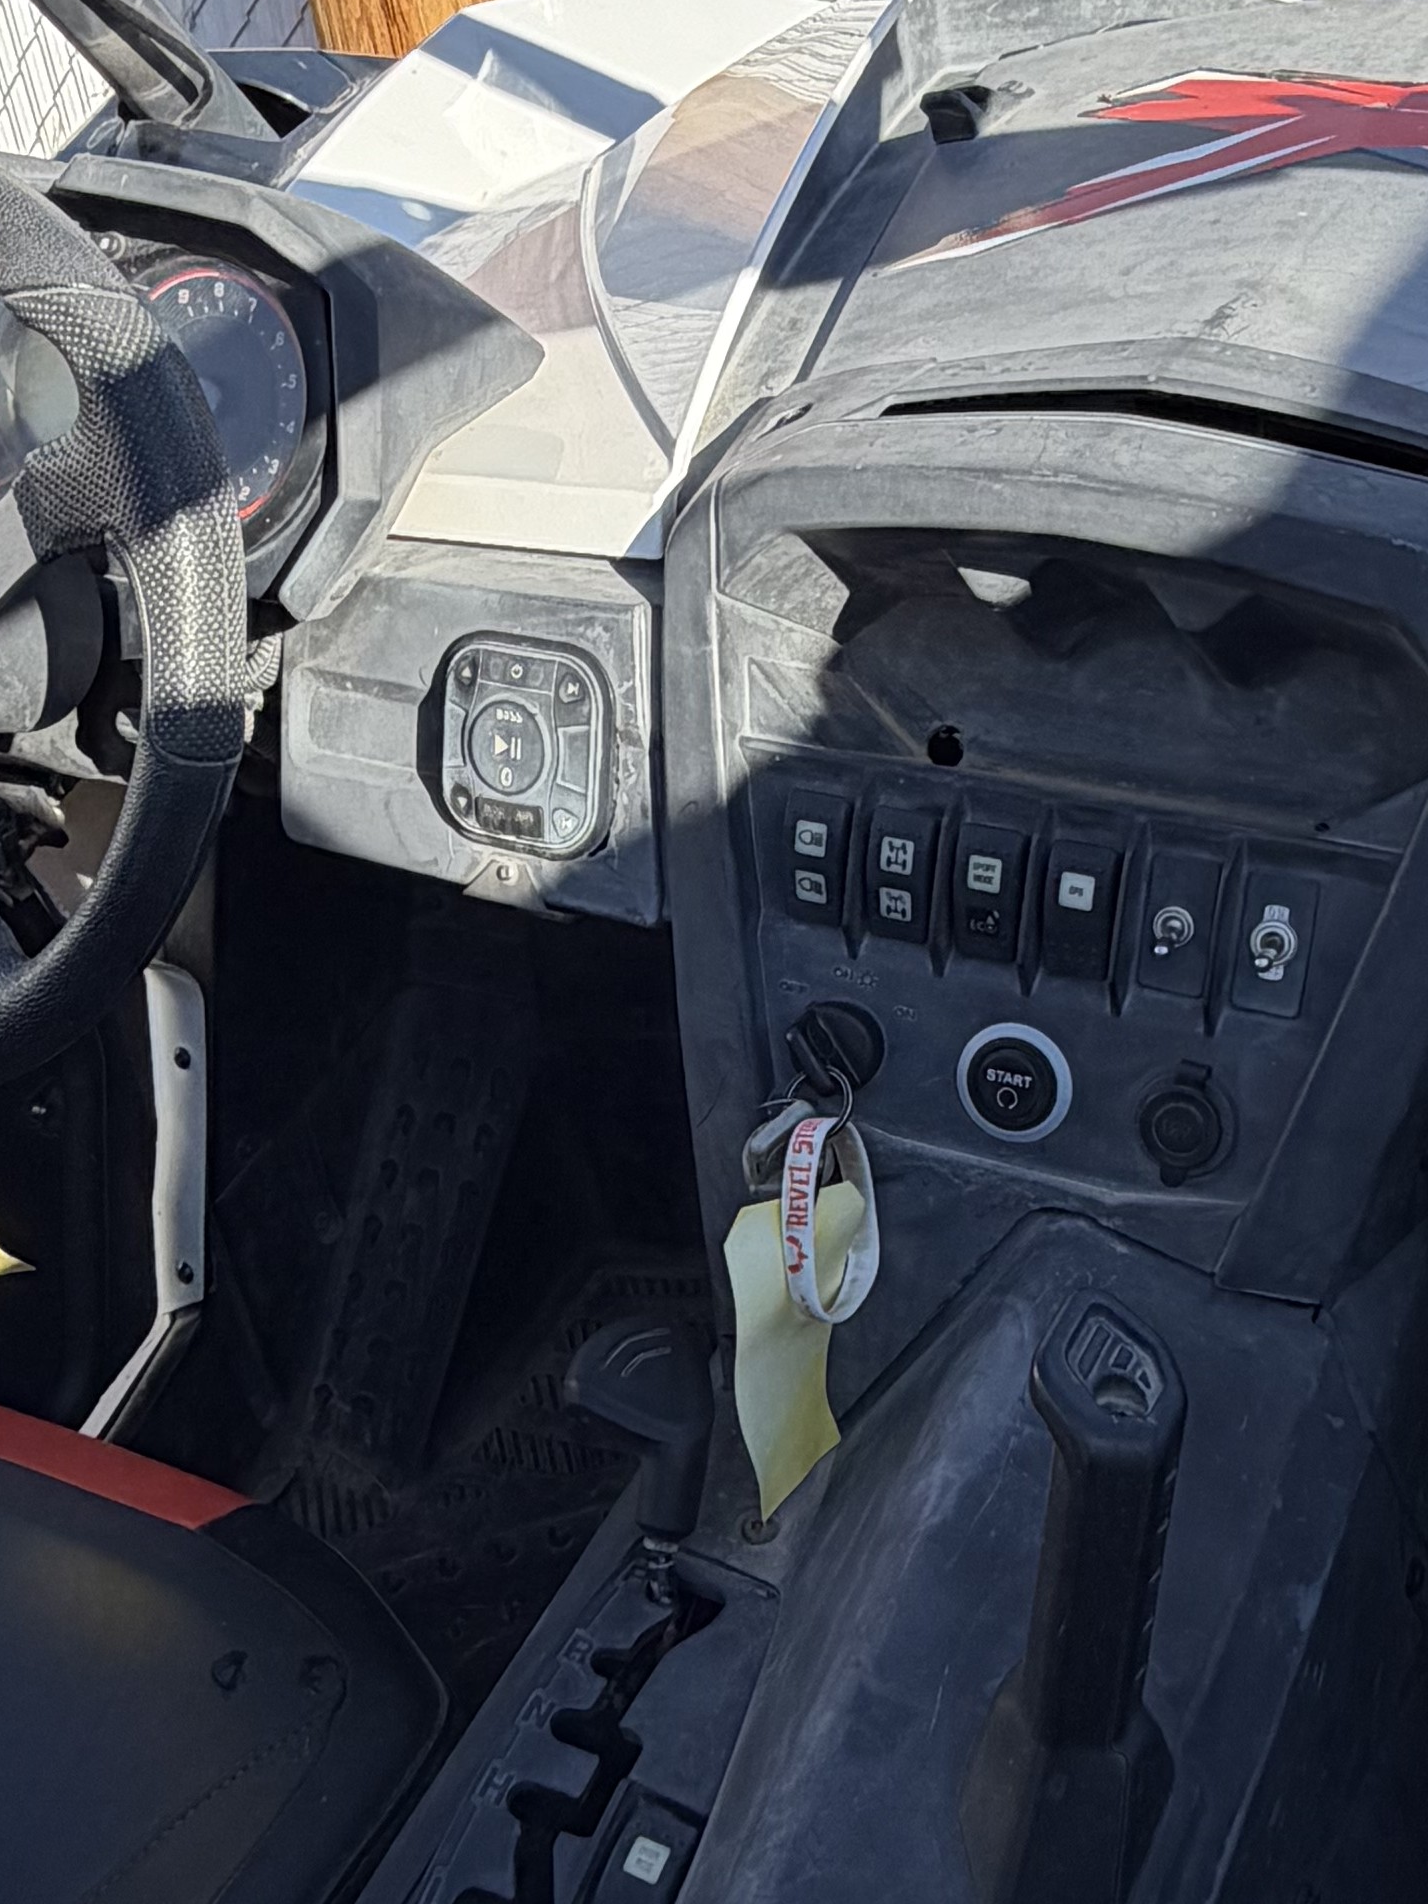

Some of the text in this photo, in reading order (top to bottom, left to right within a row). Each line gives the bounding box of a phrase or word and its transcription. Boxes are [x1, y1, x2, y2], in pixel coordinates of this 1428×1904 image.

[275, 331, 285, 346] 6
[287, 374, 297, 389] 5
[268, 458, 279, 475] 3
[238, 486, 250, 501] 2
[986, 1068, 1033, 1089] START
[786, 1163, 813, 1227] REVEL
